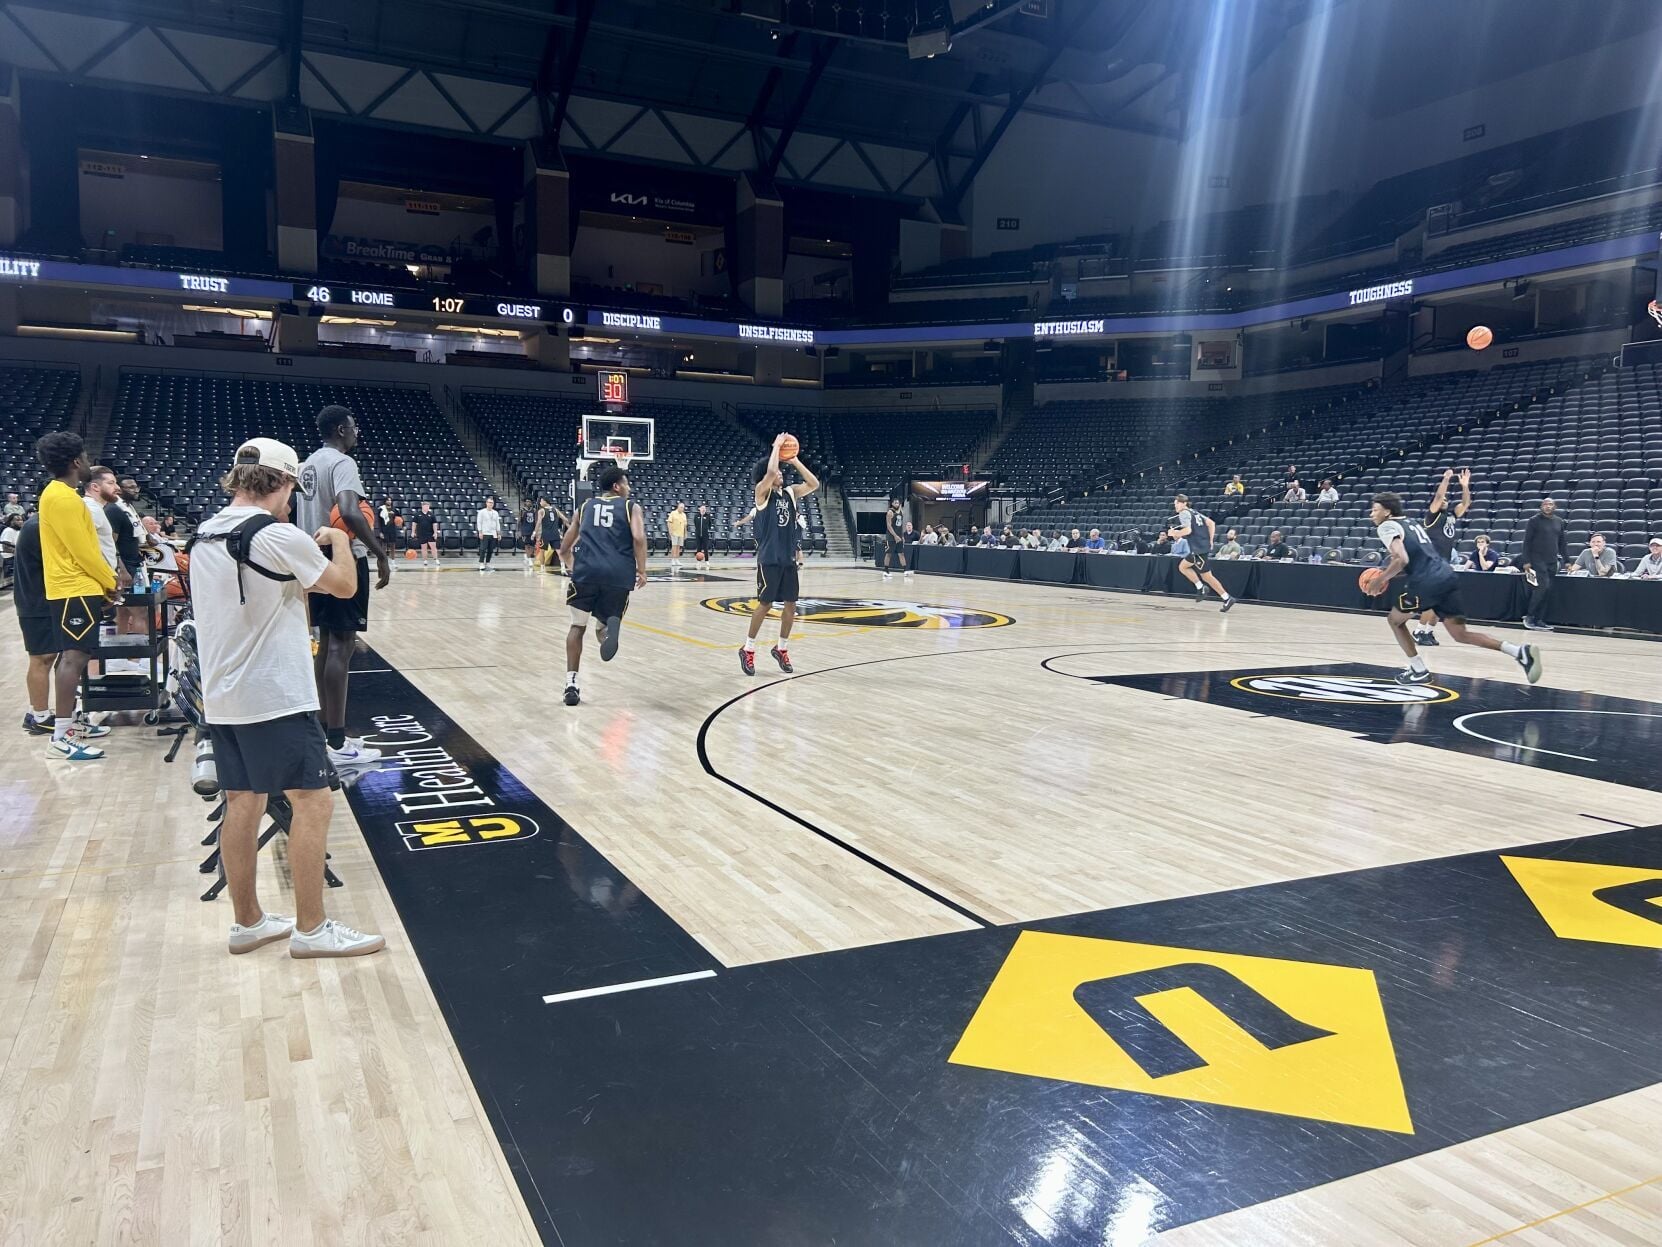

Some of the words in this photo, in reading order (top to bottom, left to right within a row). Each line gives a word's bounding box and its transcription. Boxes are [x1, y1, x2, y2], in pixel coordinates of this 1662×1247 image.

[999, 220, 1017, 228] 210
[346, 242, 416, 260] BreakTime
[180, 275, 228, 292] TRUST
[1349, 280, 1413, 304] TOUGHNESS
[308, 287, 330, 302] 46
[352, 290, 394, 306] HOME
[432, 297, 464, 313] 1:07
[497, 303, 540, 318] GUEST
[563, 309, 573, 322] 0
[602, 312, 660, 330] DISCIPLINE
[1034, 320, 1104, 335] ENTHUSIASM
[738, 325, 814, 342] UNSELFISHNESS
[1504, 349, 1518, 357] 107
[608, 374, 624, 384] 1:07
[604, 383, 622, 398] 30
[593, 504, 614, 528] 15
[360, 714, 432, 746] Care
[376, 746, 496, 814] Health
